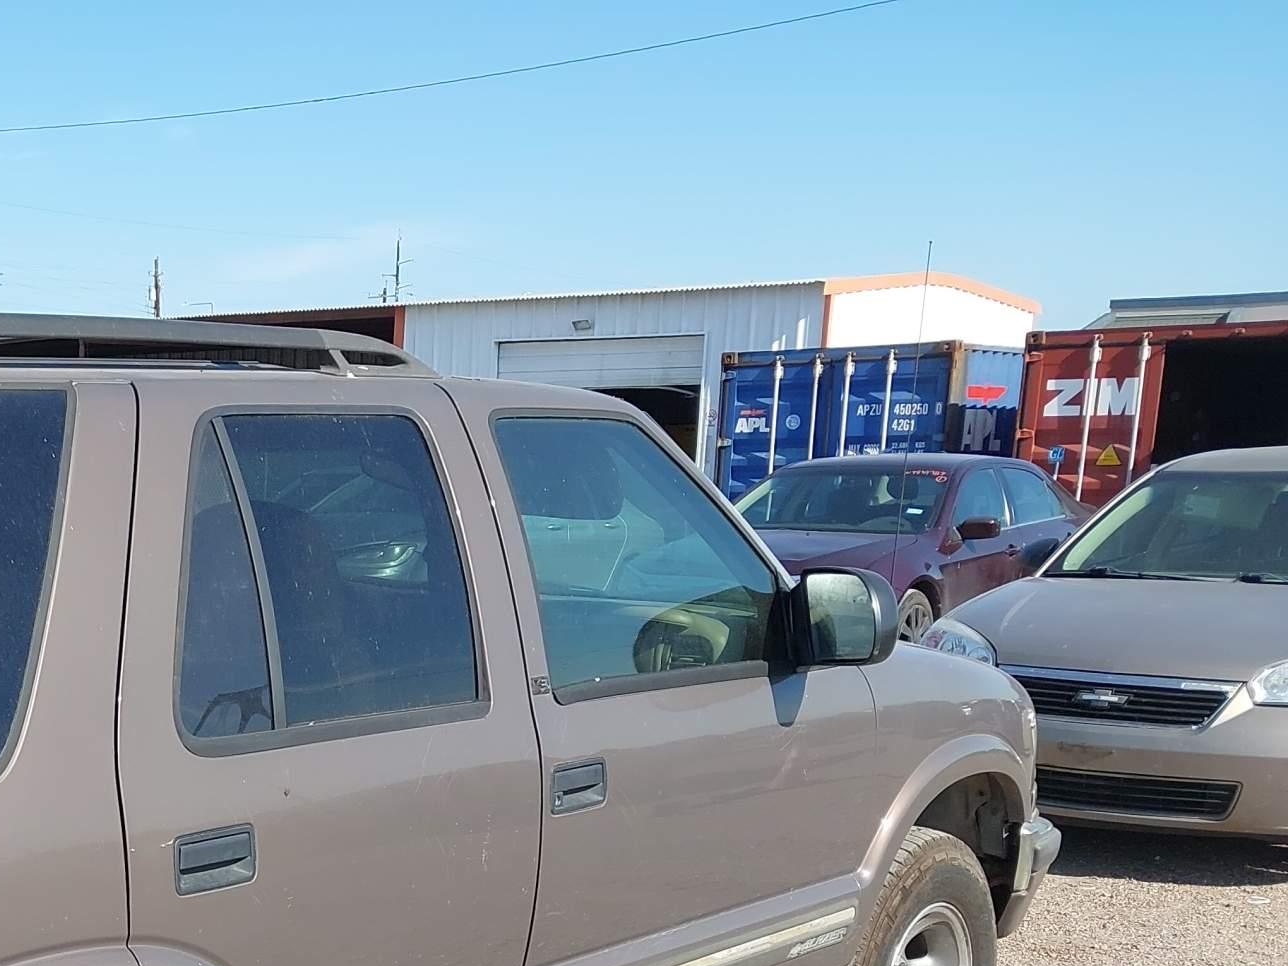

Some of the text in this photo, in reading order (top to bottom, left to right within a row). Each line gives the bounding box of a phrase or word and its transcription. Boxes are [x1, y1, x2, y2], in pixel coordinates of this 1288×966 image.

[857, 403, 882, 416] APZU
[894, 403, 928, 415] 450250
[1043, 377, 1140, 416] ZIM
[735, 417, 770, 433] APL
[961, 408, 1002, 450] APL
